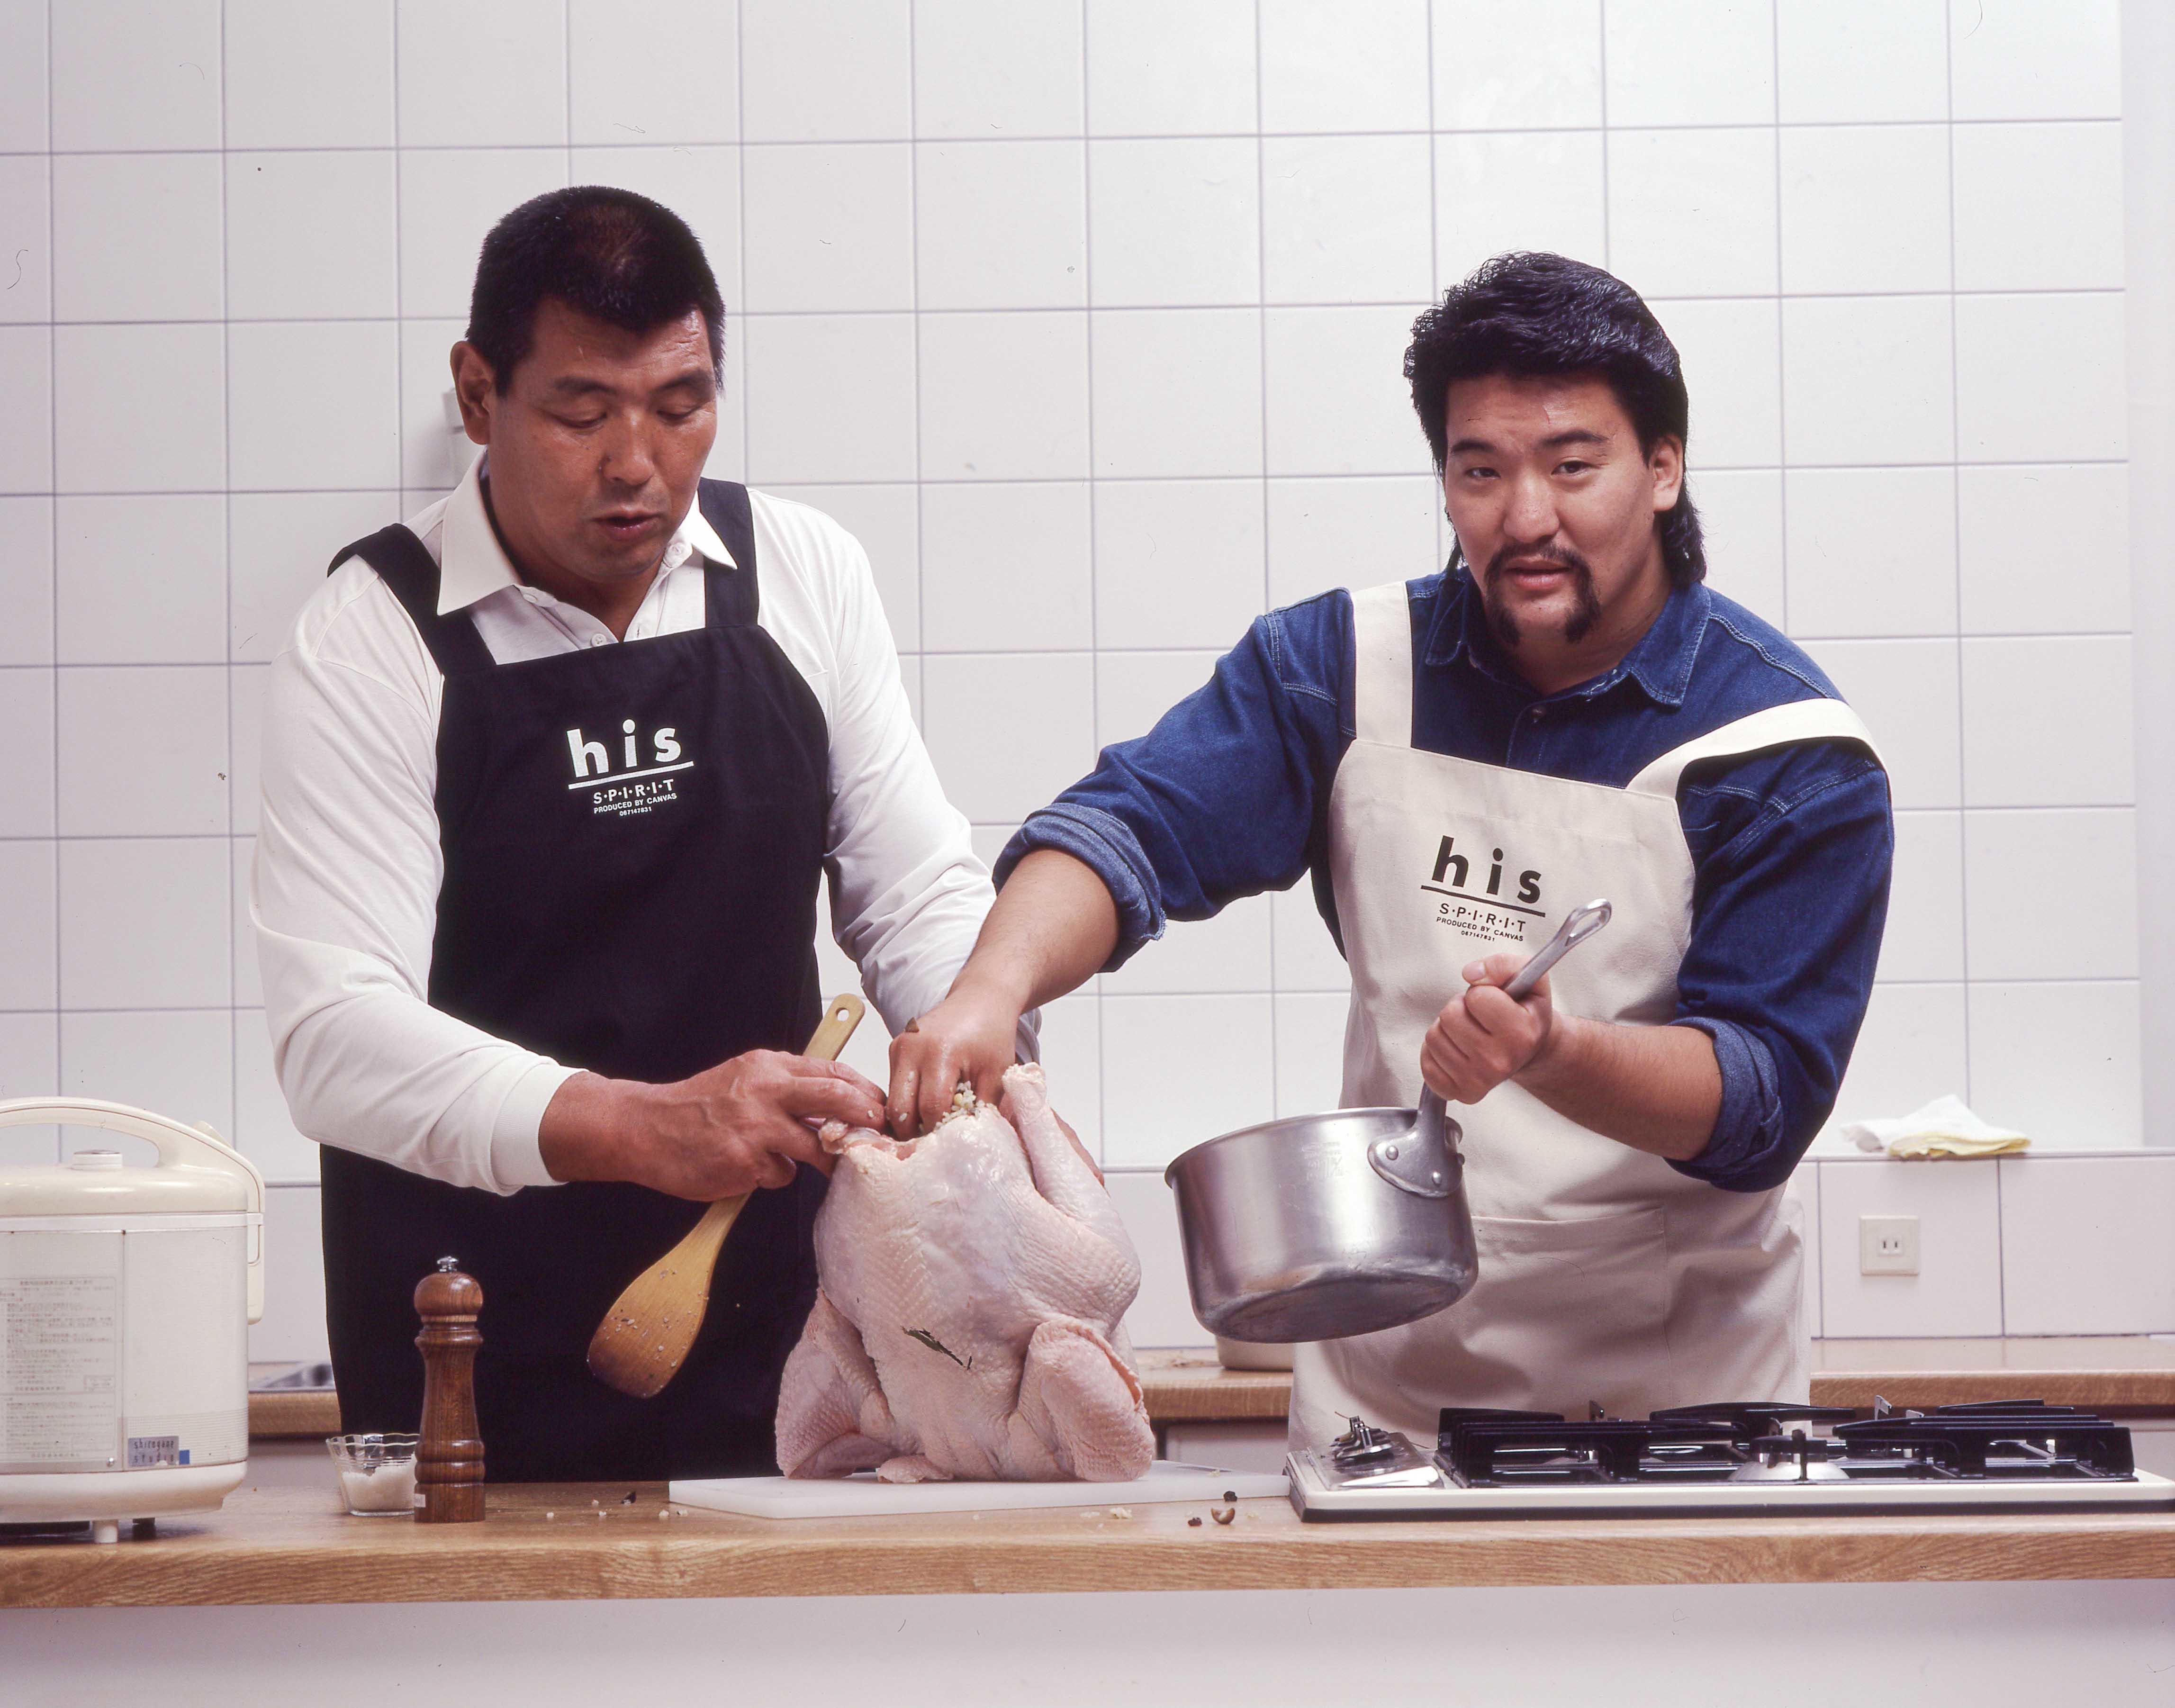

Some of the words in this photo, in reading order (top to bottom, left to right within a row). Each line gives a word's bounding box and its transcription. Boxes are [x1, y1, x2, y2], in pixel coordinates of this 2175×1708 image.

[567, 719, 681, 777] his
[594, 801, 632, 814] PRODUCED
[646, 793, 677, 804] CANVAS
[619, 806, 652, 816] 067147831
[1431, 835, 1542, 904] his
[1436, 917, 1477, 930] PRODUCED
[1494, 930, 1524, 941] CANVAS
[1461, 930, 1495, 942] 067147831
[134, 1437, 174, 1451] shirogane
